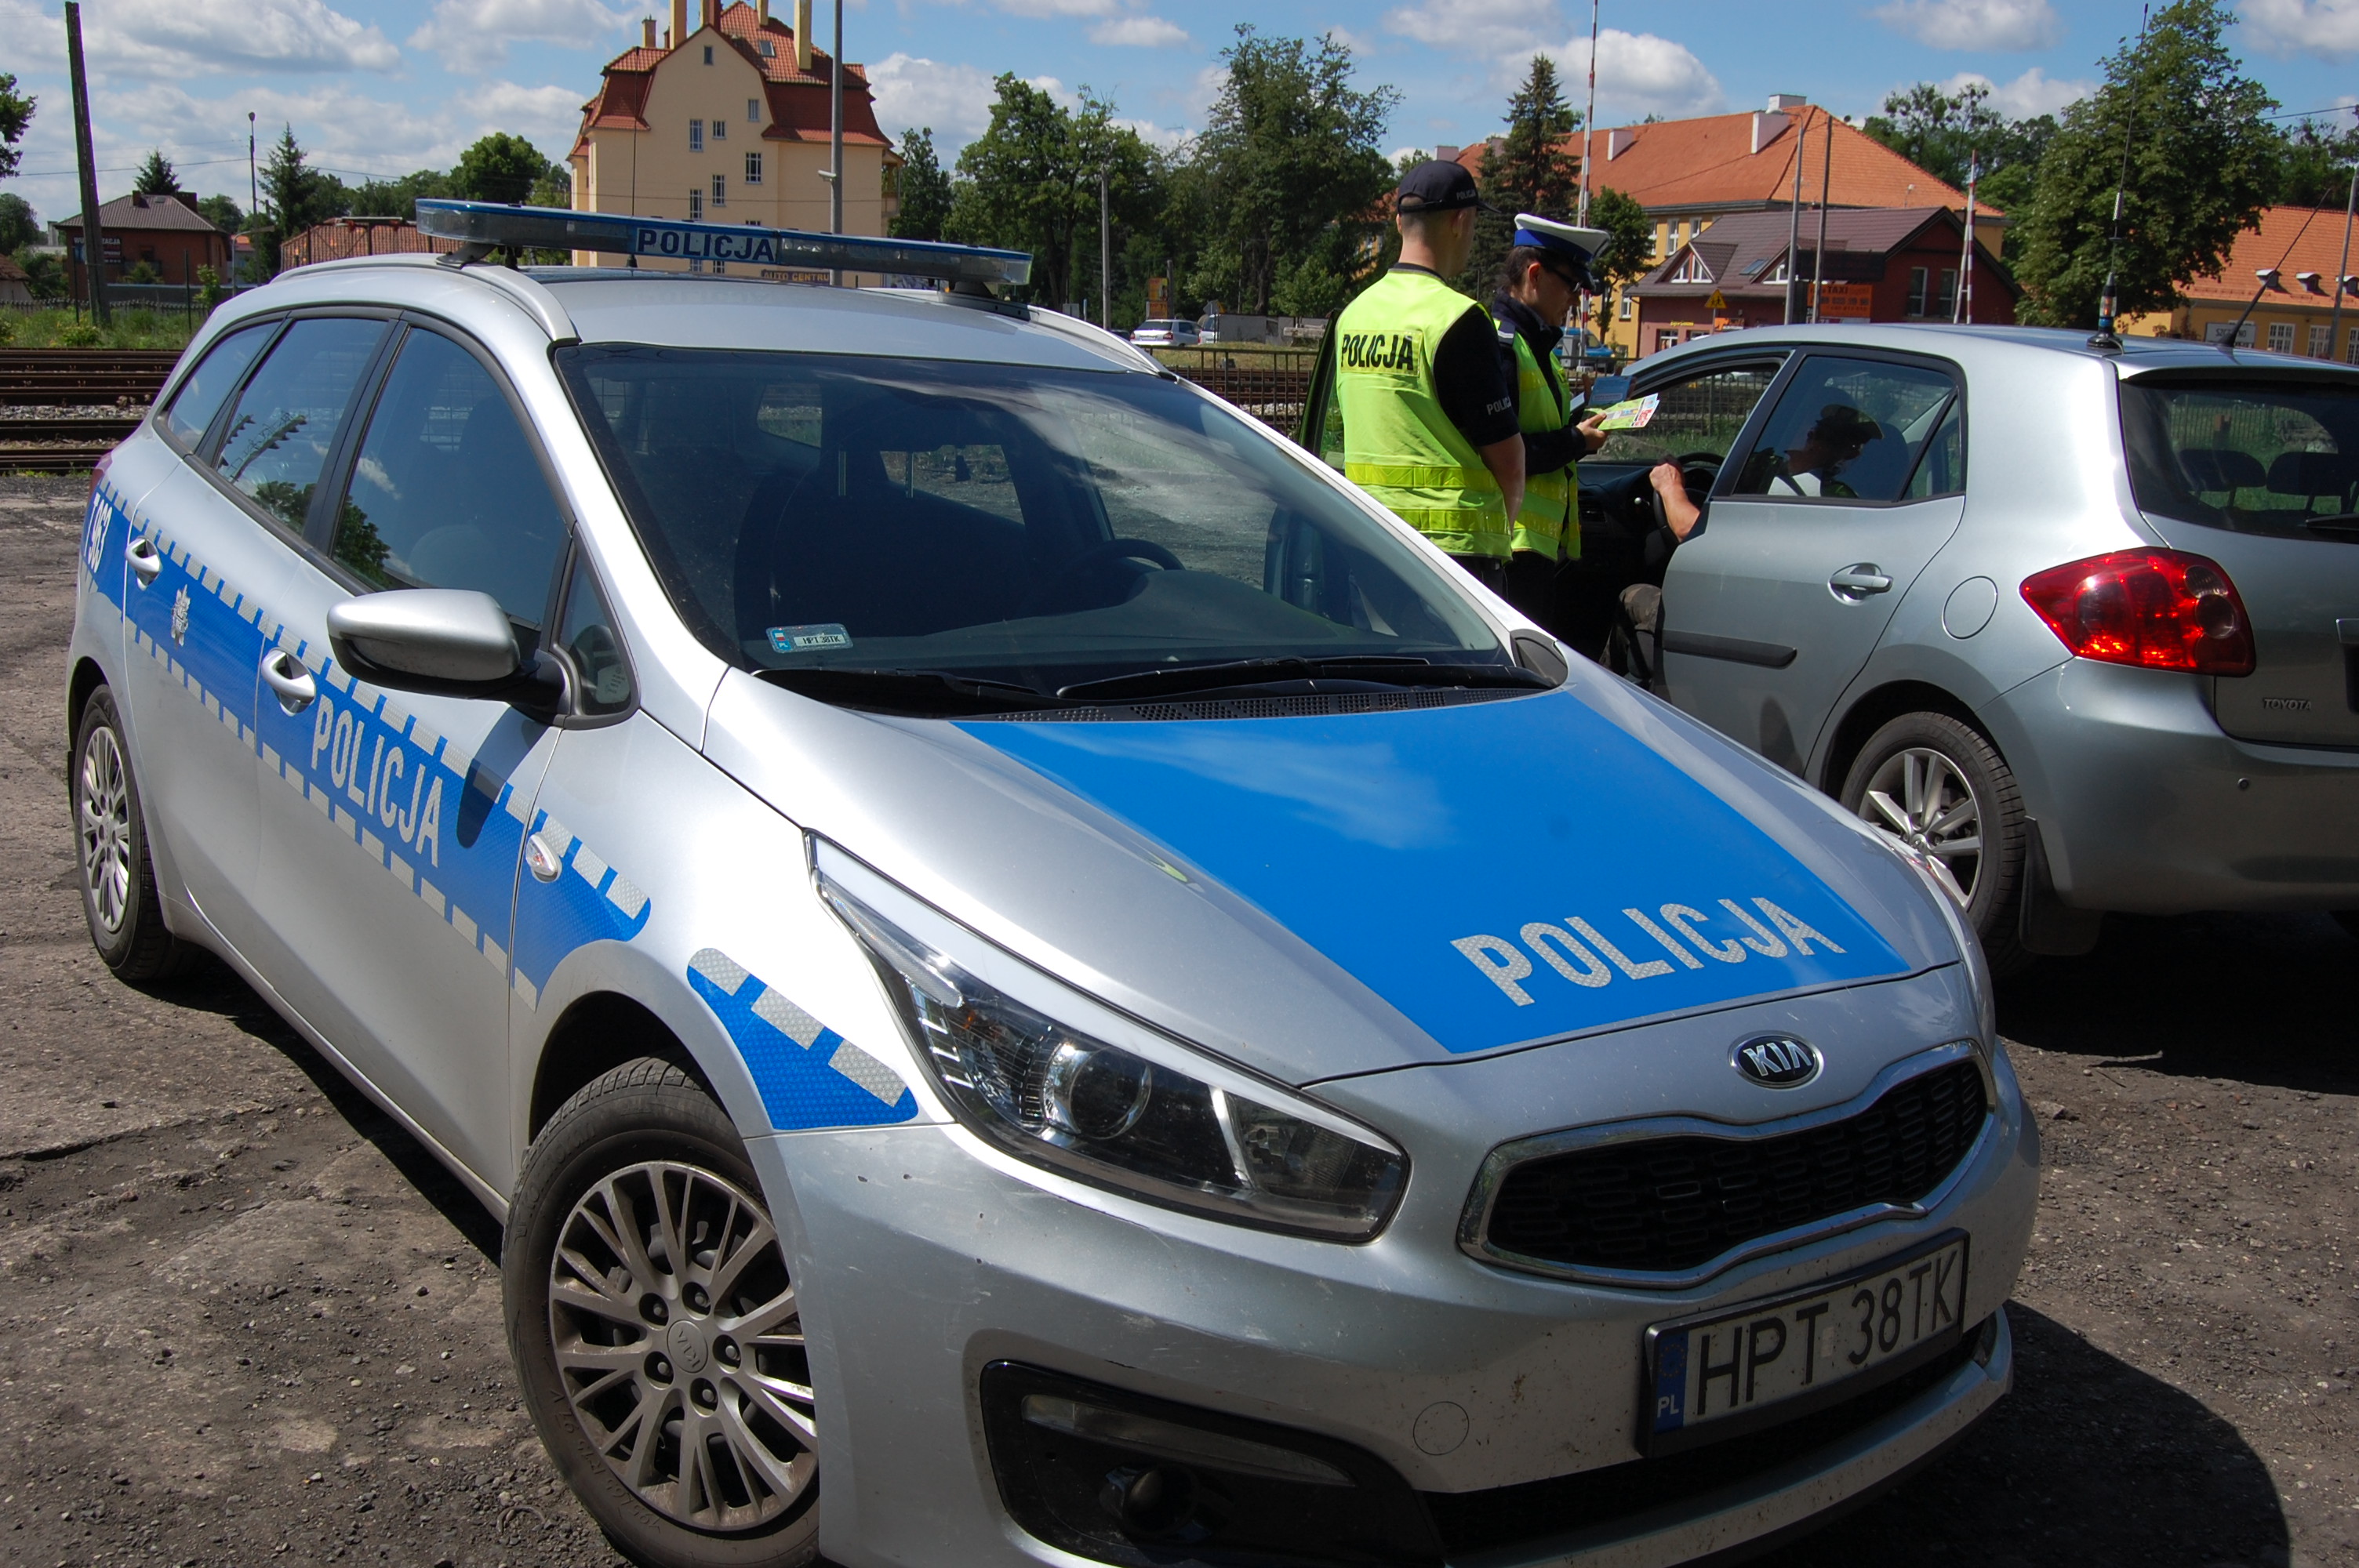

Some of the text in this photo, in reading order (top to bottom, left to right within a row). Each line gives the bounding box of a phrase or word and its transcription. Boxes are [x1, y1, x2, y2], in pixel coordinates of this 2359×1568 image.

[638, 229, 775, 262] POLICJA
[765, 271, 829, 281] AUTO CENTRU
[1341, 334, 1414, 371] POLICJA
[2263, 699, 2312, 711] TOYOTA
[311, 694, 444, 868] POLICJA
[1450, 897, 1848, 1007] POLICJA
[1743, 1040, 1812, 1077] KIA
[677, 1330, 700, 1368] KIA
[1697, 1250, 1958, 1416] HPT 38TK
[1656, 1396, 1680, 1419] PL
